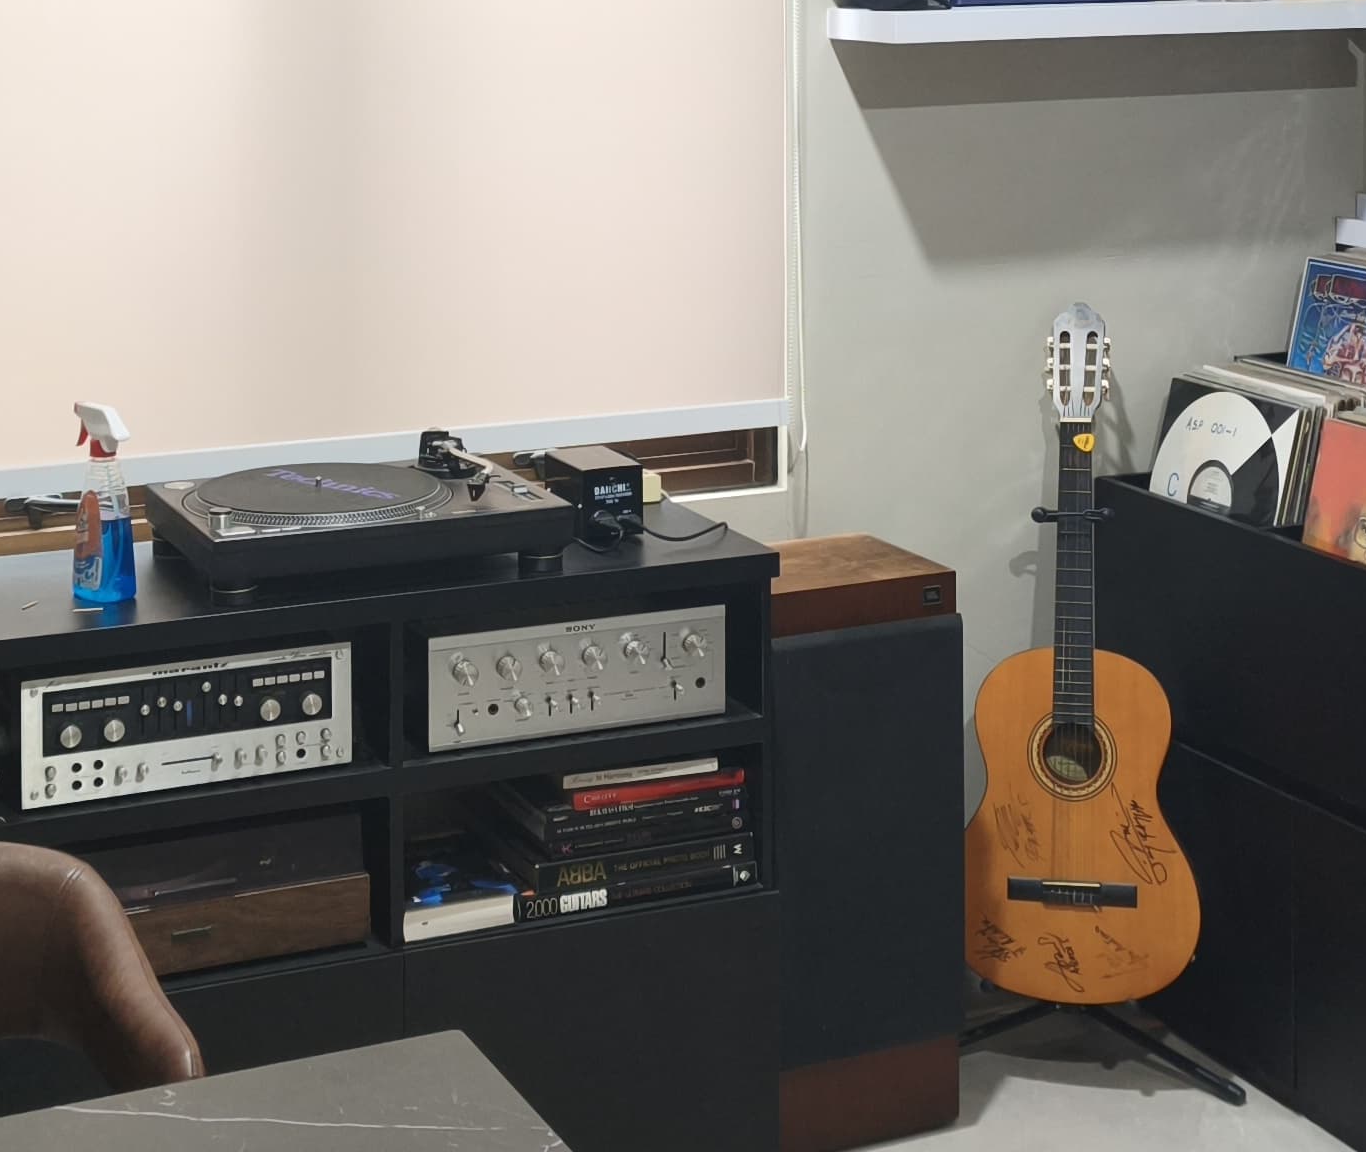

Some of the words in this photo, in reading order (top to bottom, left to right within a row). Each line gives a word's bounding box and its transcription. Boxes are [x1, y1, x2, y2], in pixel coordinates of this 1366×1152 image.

[1167, 472, 1180, 497] C
[565, 623, 596, 633] SONY
[557, 861, 607, 888] ABBA
[559, 888, 608, 914] GUITARS
